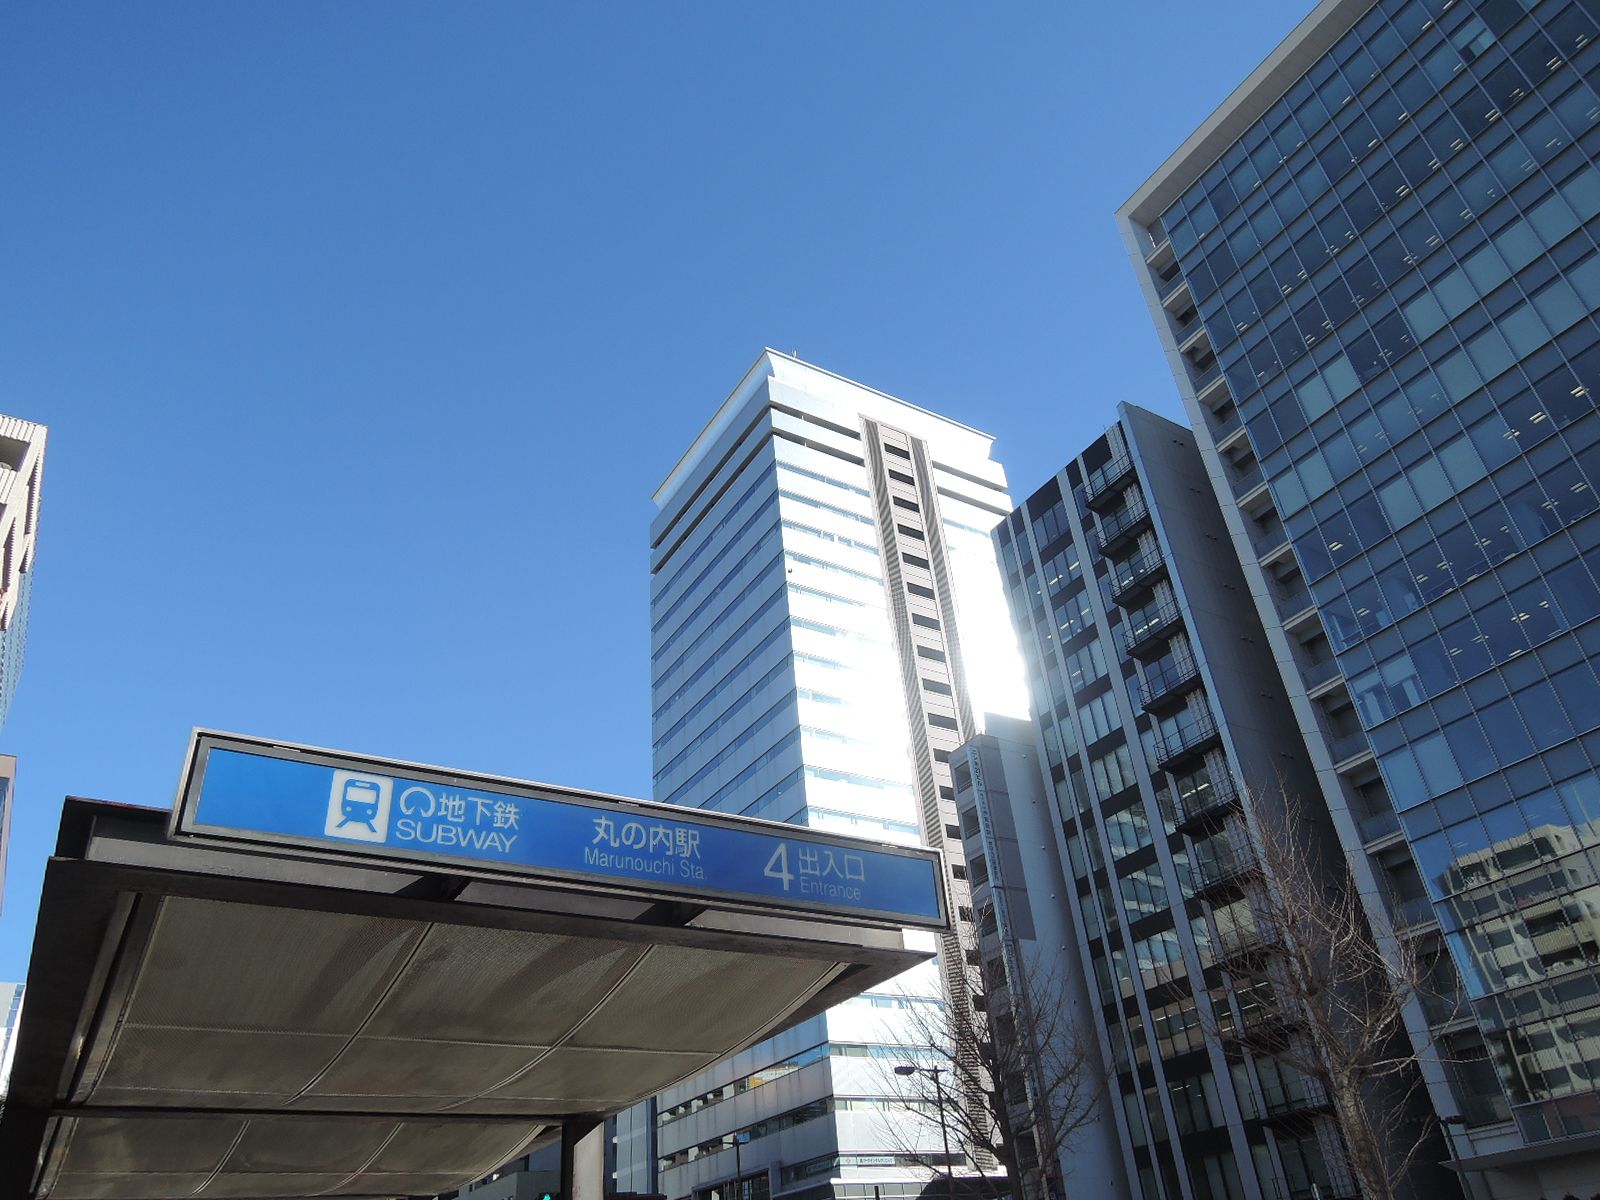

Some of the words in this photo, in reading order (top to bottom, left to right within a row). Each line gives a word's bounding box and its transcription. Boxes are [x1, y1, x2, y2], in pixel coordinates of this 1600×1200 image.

[438, 792, 519, 830] 地下鉄
[396, 820, 517, 853] SUBWAY
[592, 815, 700, 859] 丸の内駅
[583, 847, 675, 876] Marunouchi
[764, 843, 795, 891] 4
[799, 847, 865, 882] 出入口
[800, 876, 862, 901] Entrance
